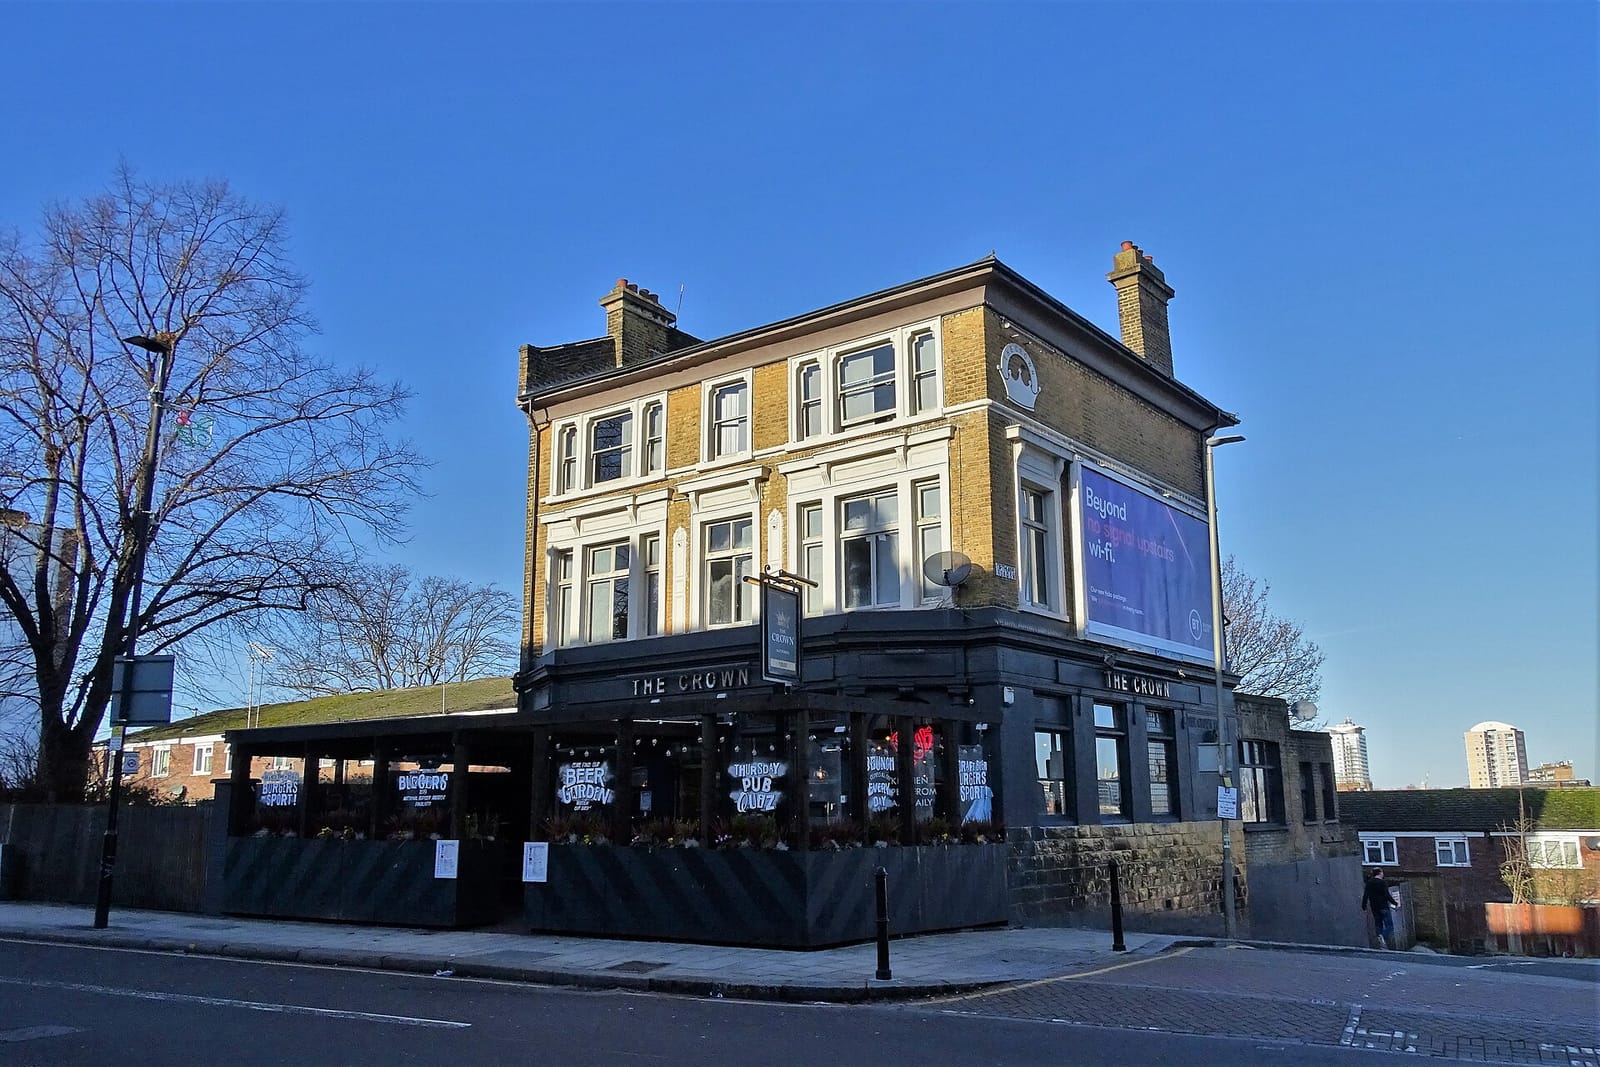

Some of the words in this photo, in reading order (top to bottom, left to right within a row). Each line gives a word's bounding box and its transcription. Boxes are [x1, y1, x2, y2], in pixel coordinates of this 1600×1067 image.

[1086, 486, 1127, 521] Beyond
[1088, 517, 1101, 534] no
[1103, 523, 1135, 548] signal
[1137, 536, 1175, 562] upstairs
[1089, 538, 1116, 563] wi-fi.
[1192, 618, 1199, 631] BT
[771, 632, 794, 646] CROWN
[632, 677, 665, 696] THE
[679, 669, 749, 691] CROWN
[1104, 671, 1128, 691] THE
[1134, 677, 1170, 698] CROWN
[734, 762, 780, 777] THURSDAY
[958, 760, 975, 772] RAFT
[399, 773, 449, 791] BURGERS
[566, 767, 606, 788] BEER
[742, 776, 772, 793] PUB
[959, 771, 987, 786] URGERS
[262, 781, 298, 795] BURGERS
[561, 784, 609, 806] GARDEN
[868, 782, 891, 797] EVERY
[960, 785, 989, 802] SPORT!
[266, 793, 297, 807] SPORT!
[736, 792, 776, 813] QUIZ
[873, 795, 887, 808] DAY
[915, 798, 934, 807] AILY
